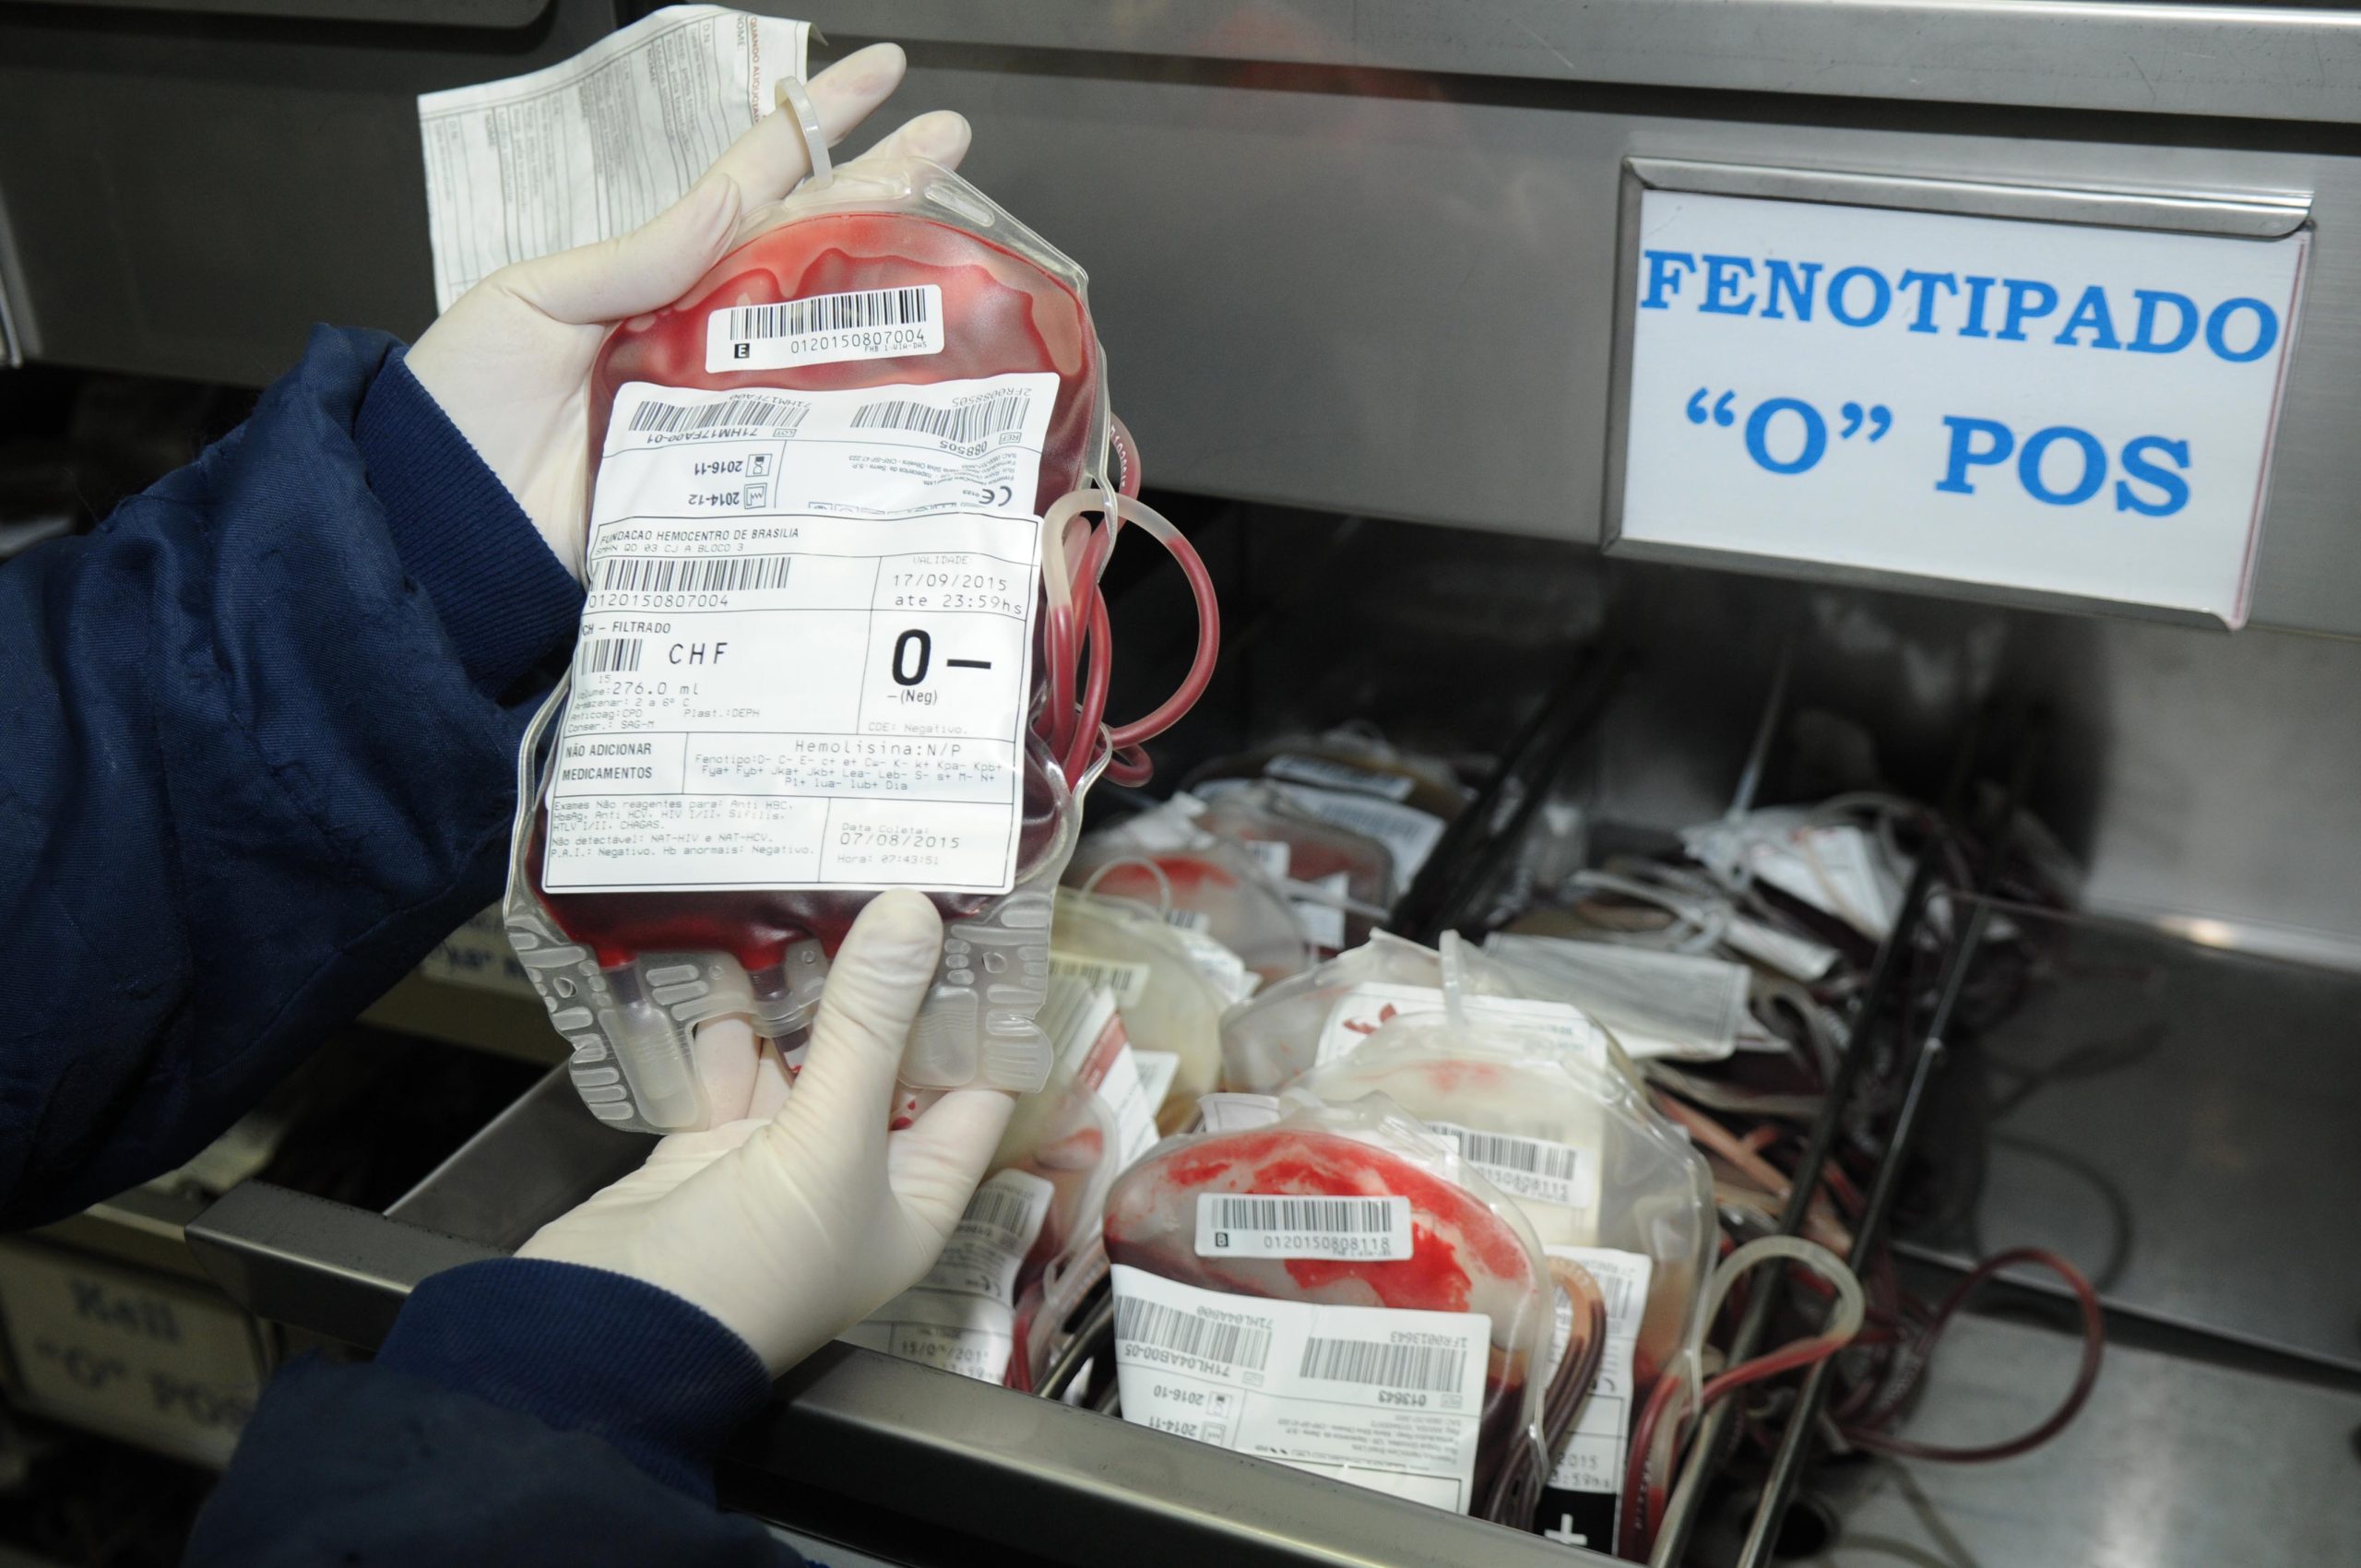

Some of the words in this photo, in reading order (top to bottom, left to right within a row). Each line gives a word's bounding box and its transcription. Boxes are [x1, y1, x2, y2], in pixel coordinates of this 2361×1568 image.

[1640, 250, 2279, 362] FENOTIPADO
[790, 328, 925, 354] 0120150807004
[647, 428, 758, 444] 71HM17FA00-01
[940, 441, 988, 457] 088505
[694, 461, 743, 475] 2016-11
[1935, 415, 2192, 517] POS
[688, 493, 740, 505] 2014-12
[600, 530, 652, 545] FUNDACAO
[657, 529, 730, 541] HEMOCENTRO
[733, 529, 747, 540] DE
[752, 528, 799, 539] BRASILIA
[697, 543, 731, 553] BLOCO
[737, 542, 743, 552] 3
[893, 574, 1007, 591] 17/09/2015
[588, 593, 729, 609] 0120150807004
[896, 595, 928, 607] ate
[943, 594, 1023, 614] 23:59hs
[612, 621, 671, 634] FILTRADO
[669, 642, 729, 665] CHF
[680, 683, 699, 695] ml
[635, 698, 643, 707] 2
[682, 698, 690, 707] C
[566, 743, 586, 757] NÃO
[590, 742, 652, 756] ADICIONAR
[795, 740, 961, 756] Hemolisina:N/P
[563, 766, 653, 781] MEDICAMENTOS
[623, 801, 682, 811] reagentes
[840, 832, 960, 849] 07/08/2015
[1264, 1235, 1390, 1252] 0120150808118
[1124, 1343, 1230, 1378] 71HL04AB00-05
[1154, 1384, 1204, 1406] 2016-10
[1149, 1416, 1197, 1437] 2014-11
